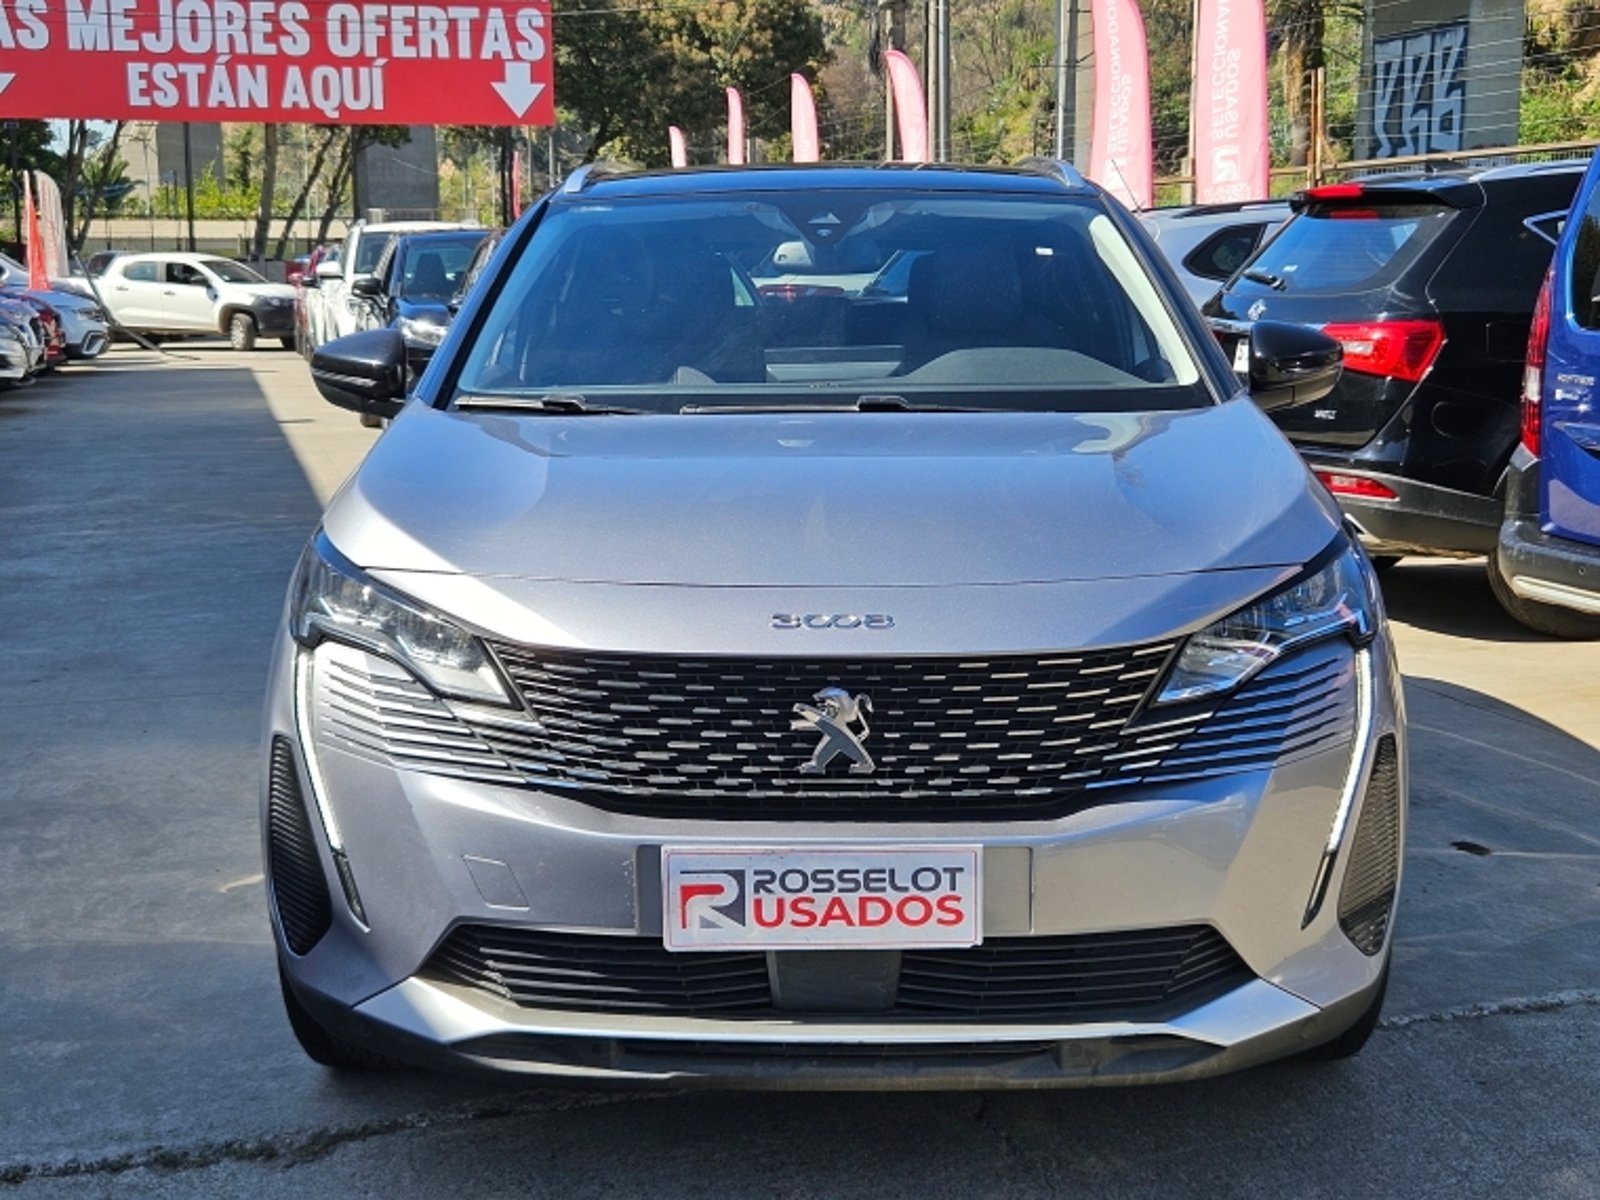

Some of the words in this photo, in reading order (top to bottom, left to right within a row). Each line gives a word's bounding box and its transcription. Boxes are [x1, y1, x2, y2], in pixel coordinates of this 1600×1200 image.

[65, 0, 310, 56] MEJORES
[326, 4, 545, 61] OFERTAS
[127, 54, 269, 108] ESTÁN
[281, 58, 389, 119] AQUÍ
[769, 614, 895, 628] 3008
[753, 867, 964, 894] ROSSELOT
[753, 895, 965, 928] USADOS
